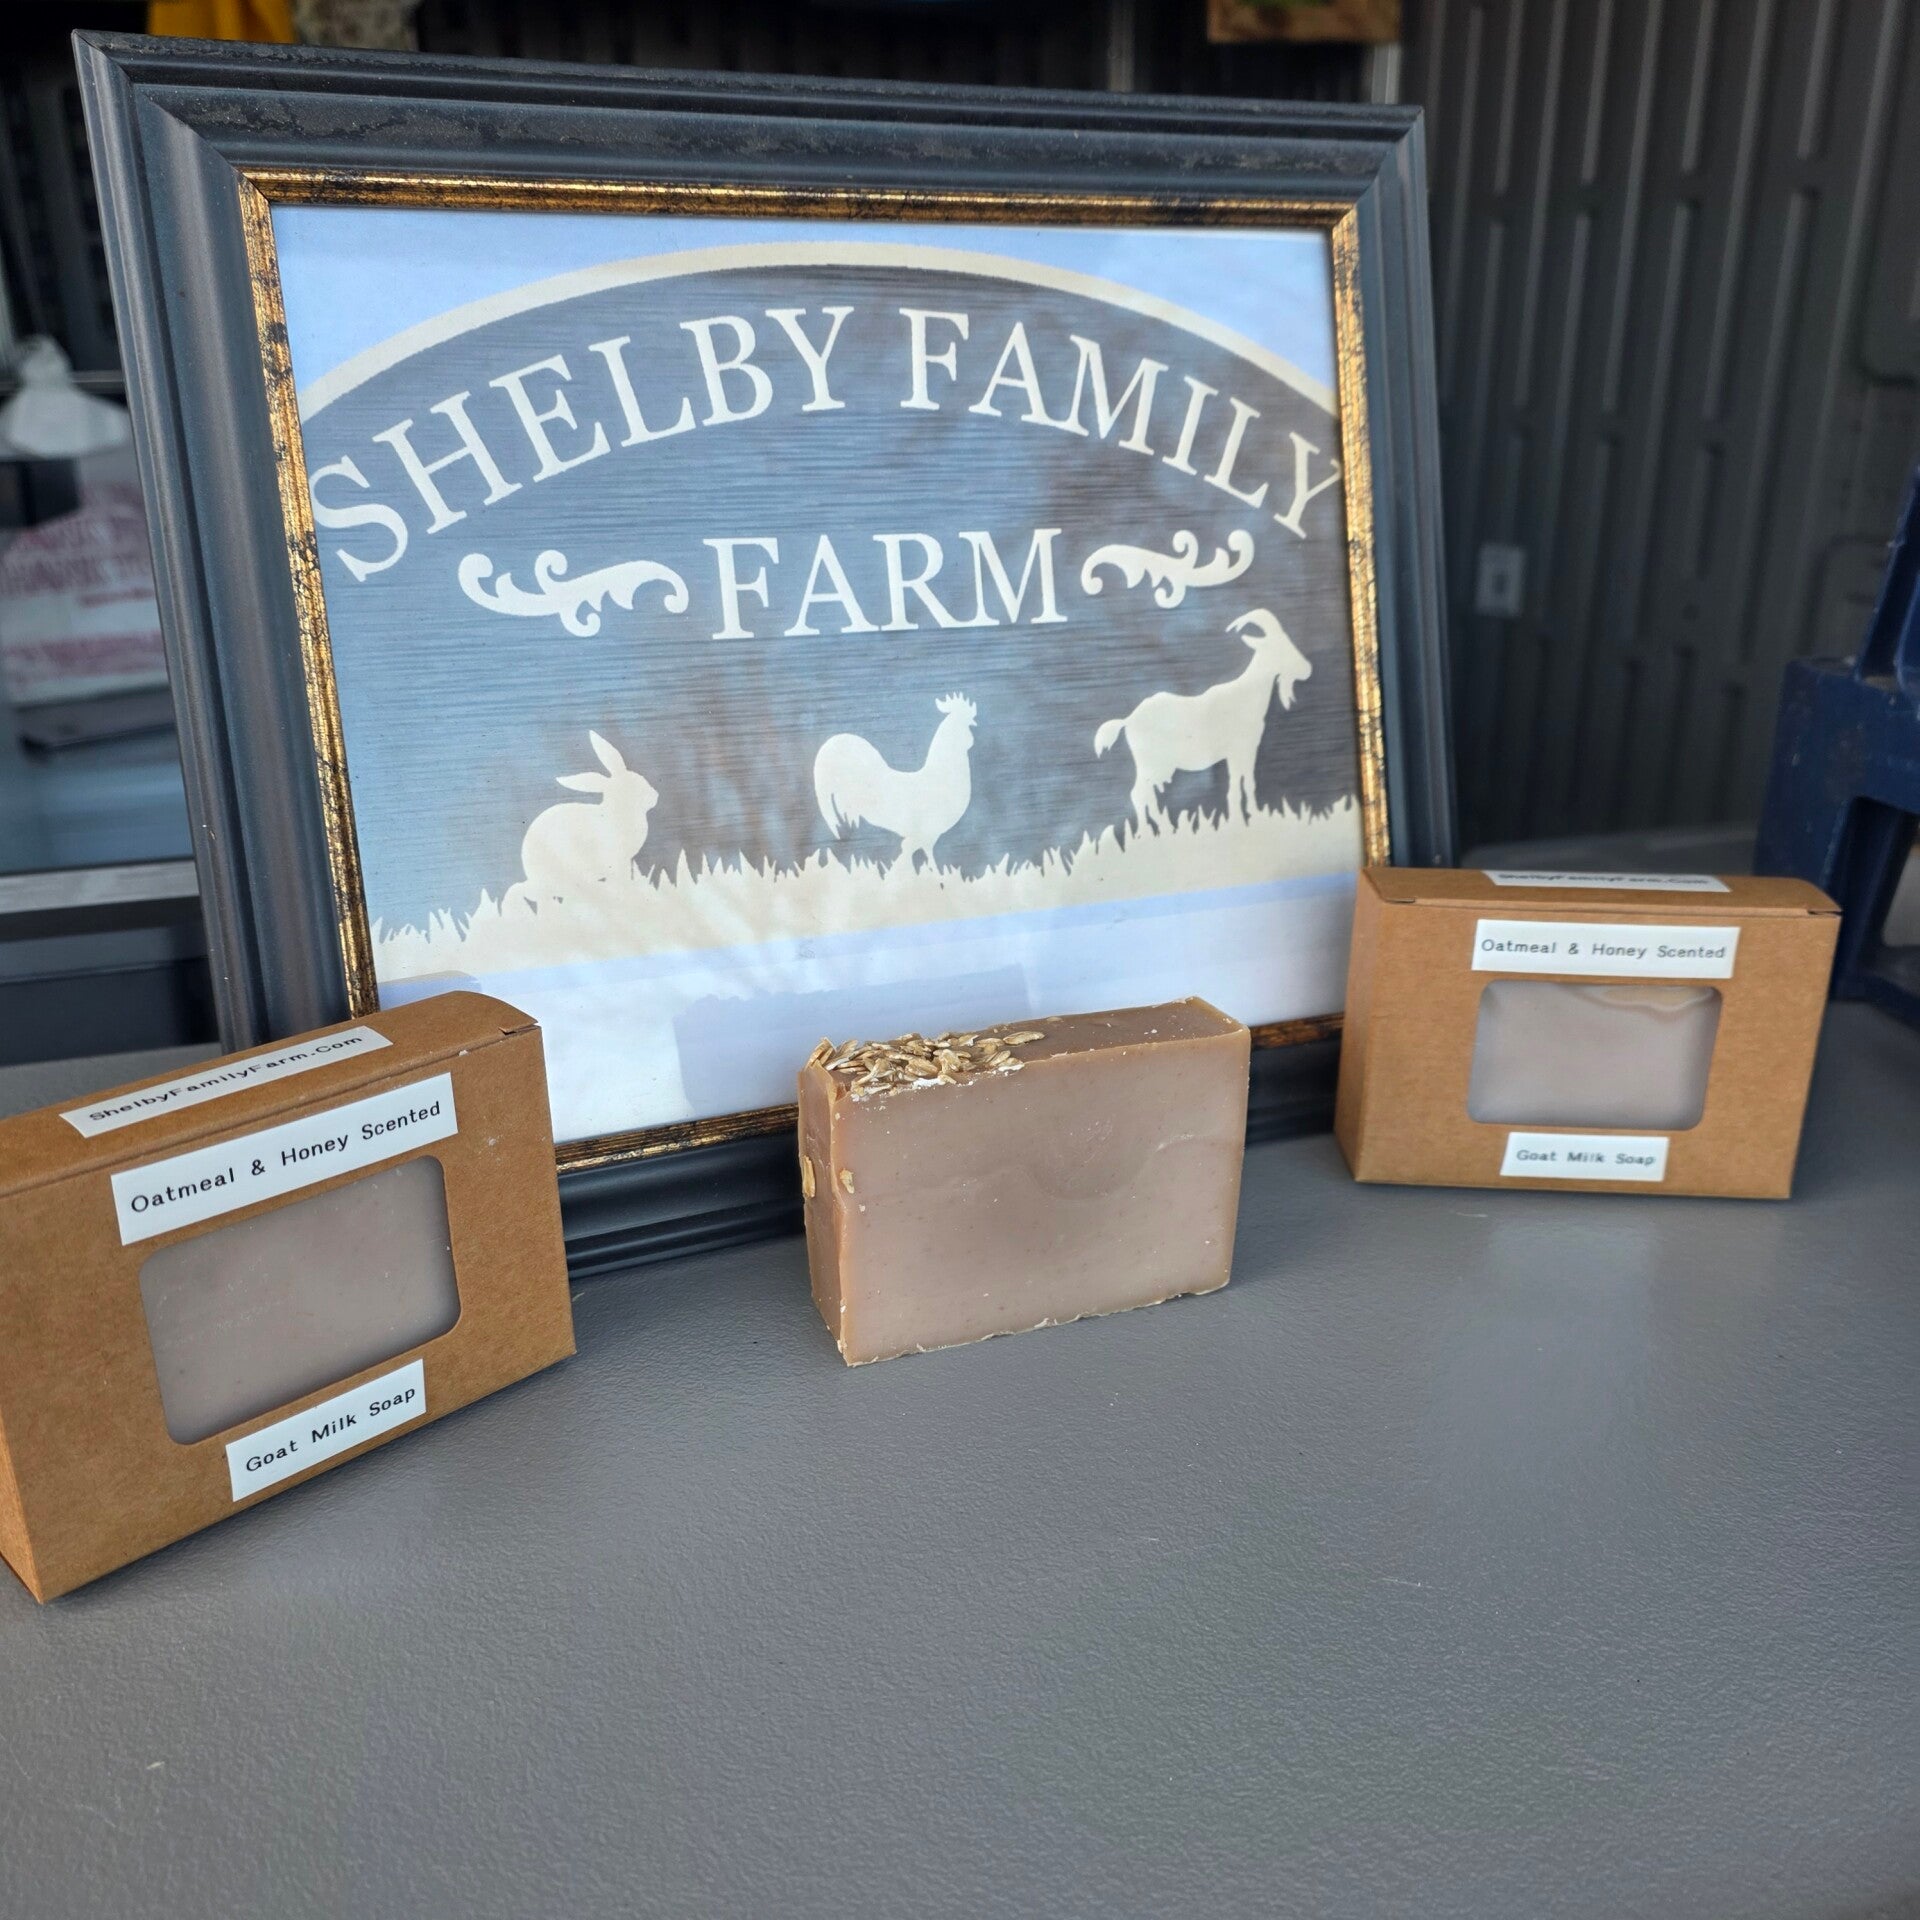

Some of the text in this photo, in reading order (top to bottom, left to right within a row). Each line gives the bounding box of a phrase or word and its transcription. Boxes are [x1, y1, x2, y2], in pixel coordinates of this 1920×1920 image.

[310, 305, 1341, 582] SHELBY FAMILY
[703, 528, 1068, 640] FARM
[1481, 939, 1726, 960] Oatmeal & Honey Scented
[88, 1034, 362, 1121] ShelbyFamilyFarm.Com
[130, 1101, 441, 1214] Oatmeal & Honey Scented
[1517, 1149, 1655, 1168] Goat Milk Soap
[246, 1388, 416, 1473] Goat Milk Soap
